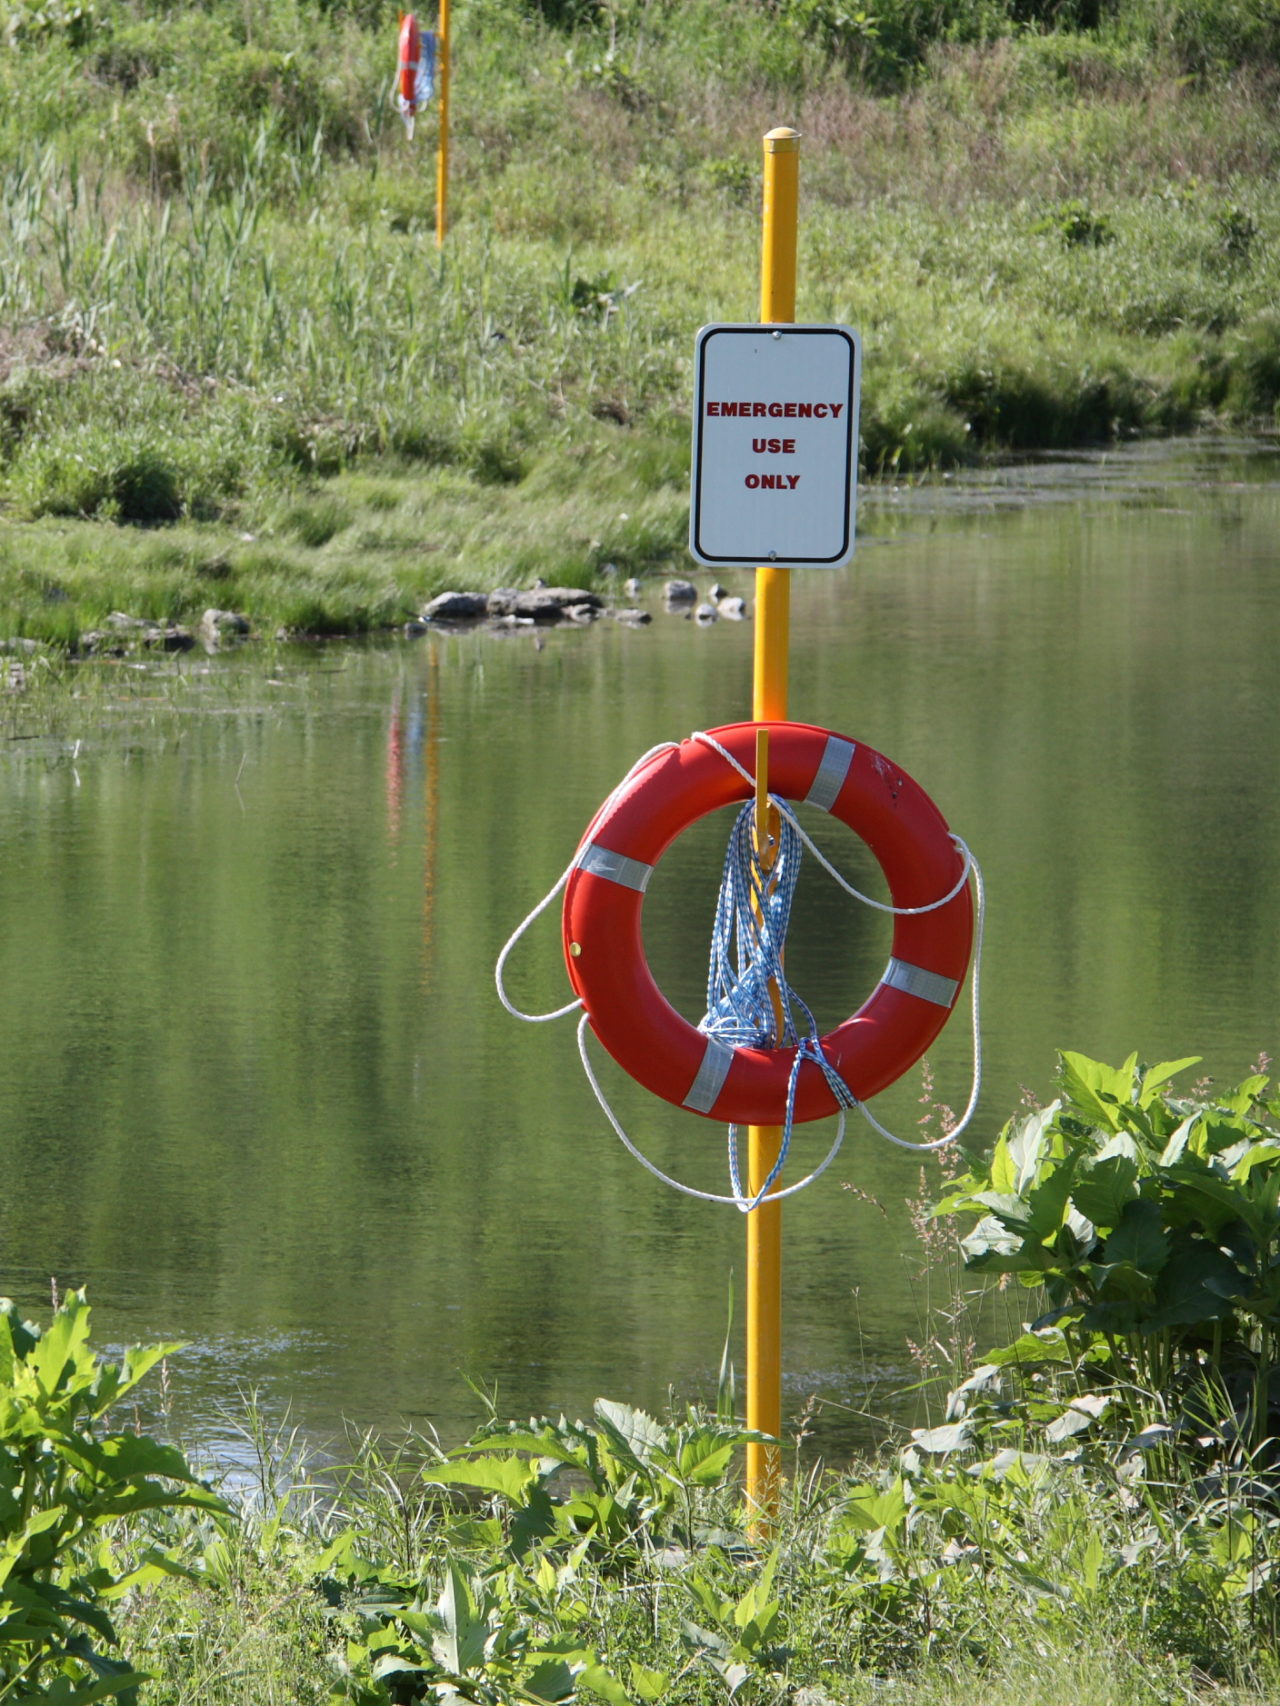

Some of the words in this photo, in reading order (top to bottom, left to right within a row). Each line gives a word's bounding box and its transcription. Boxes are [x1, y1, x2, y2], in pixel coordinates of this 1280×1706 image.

[706, 402, 843, 418] EMERGENCY
[752, 438, 796, 453] USE
[744, 474, 800, 489] ONLY
